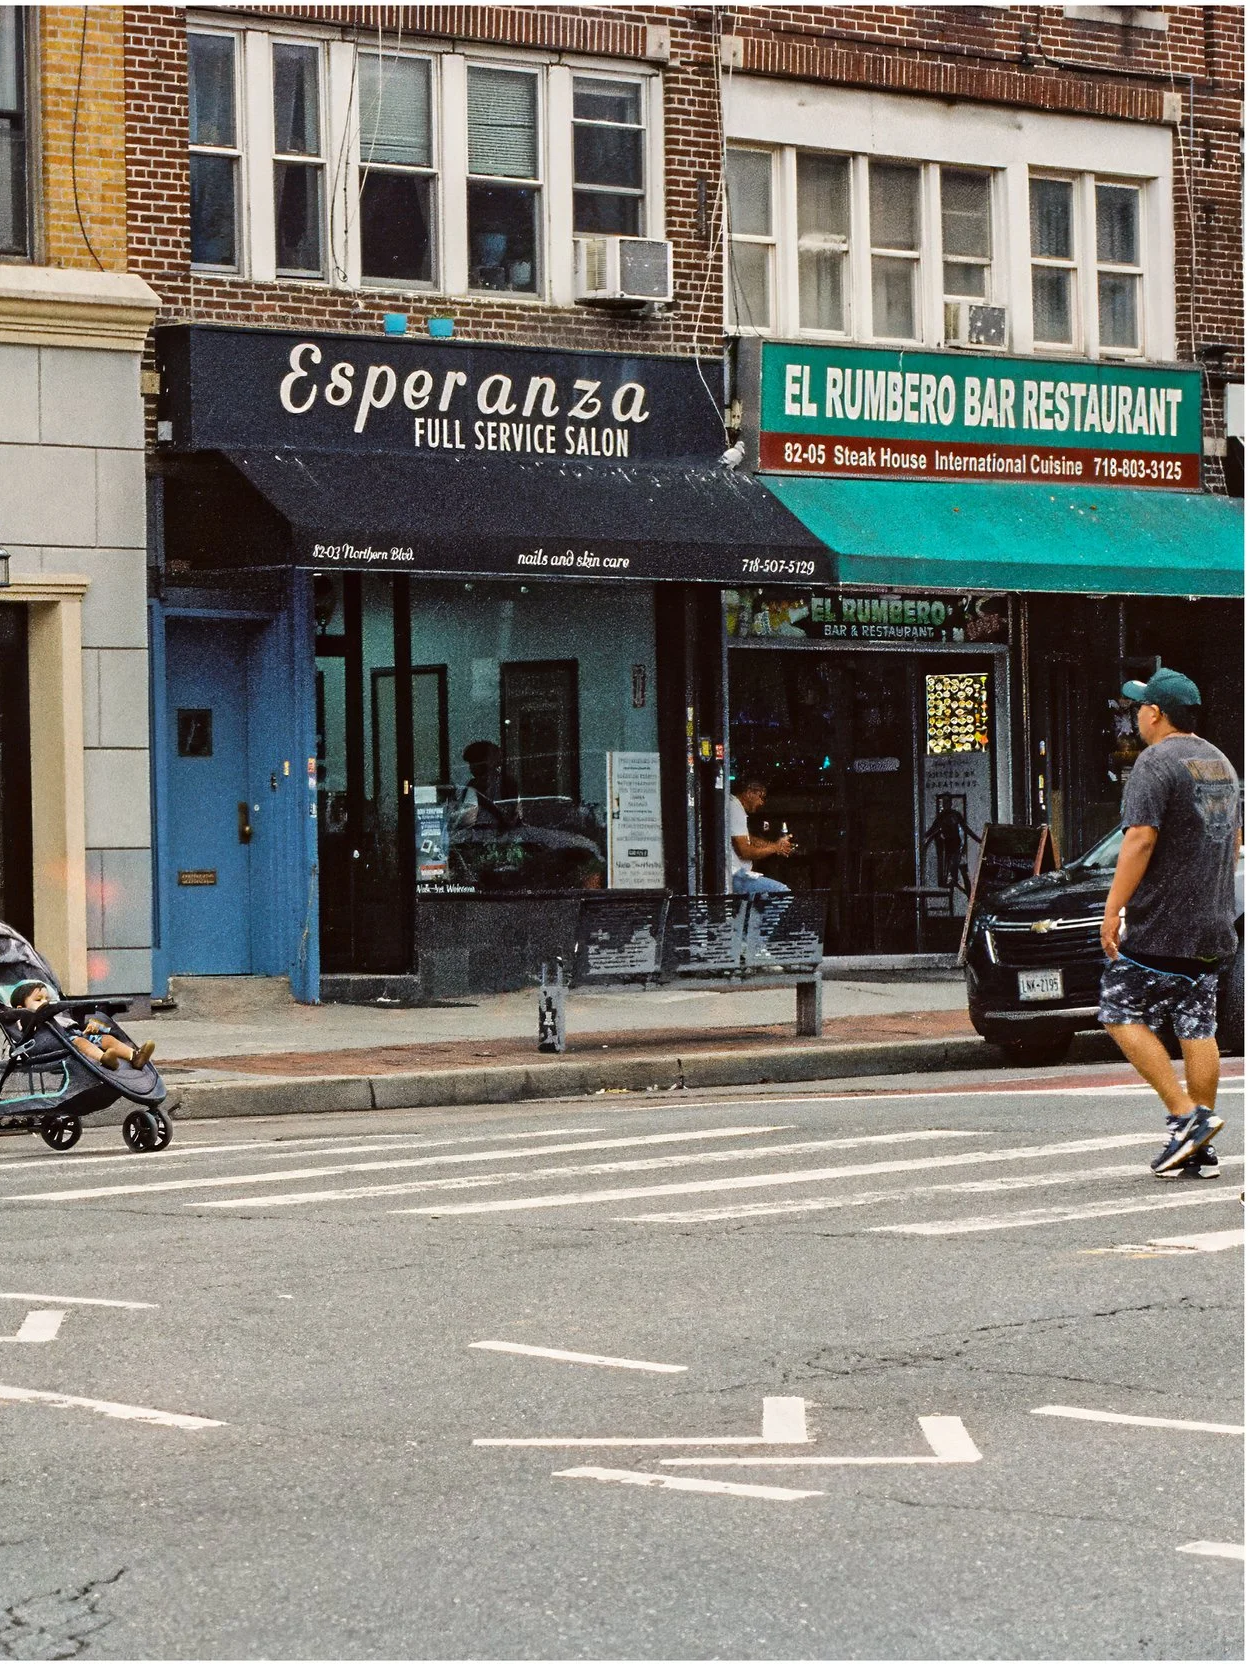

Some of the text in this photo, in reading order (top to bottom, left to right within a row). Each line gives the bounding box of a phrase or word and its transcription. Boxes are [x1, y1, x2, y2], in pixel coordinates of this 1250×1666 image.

[280, 343, 649, 433] Esperanza
[785, 364, 1182, 437] EL RUMBERO BAR RESTAURANT
[414, 417, 629, 458] FULL SERVICE SALON
[784, 441, 1182, 480] 82-05 Steak House International Cuisine 718-803-3125
[312, 544, 341, 560] 82-03
[342, 543, 388, 563] Northern
[517, 548, 630, 568] nails and skin care
[742, 557, 815, 575] 718-507-5129
[811, 597, 947, 626] EL RUMBERO
[824, 624, 847, 636] BAR
[861, 625, 934, 638] RESTAURANT
